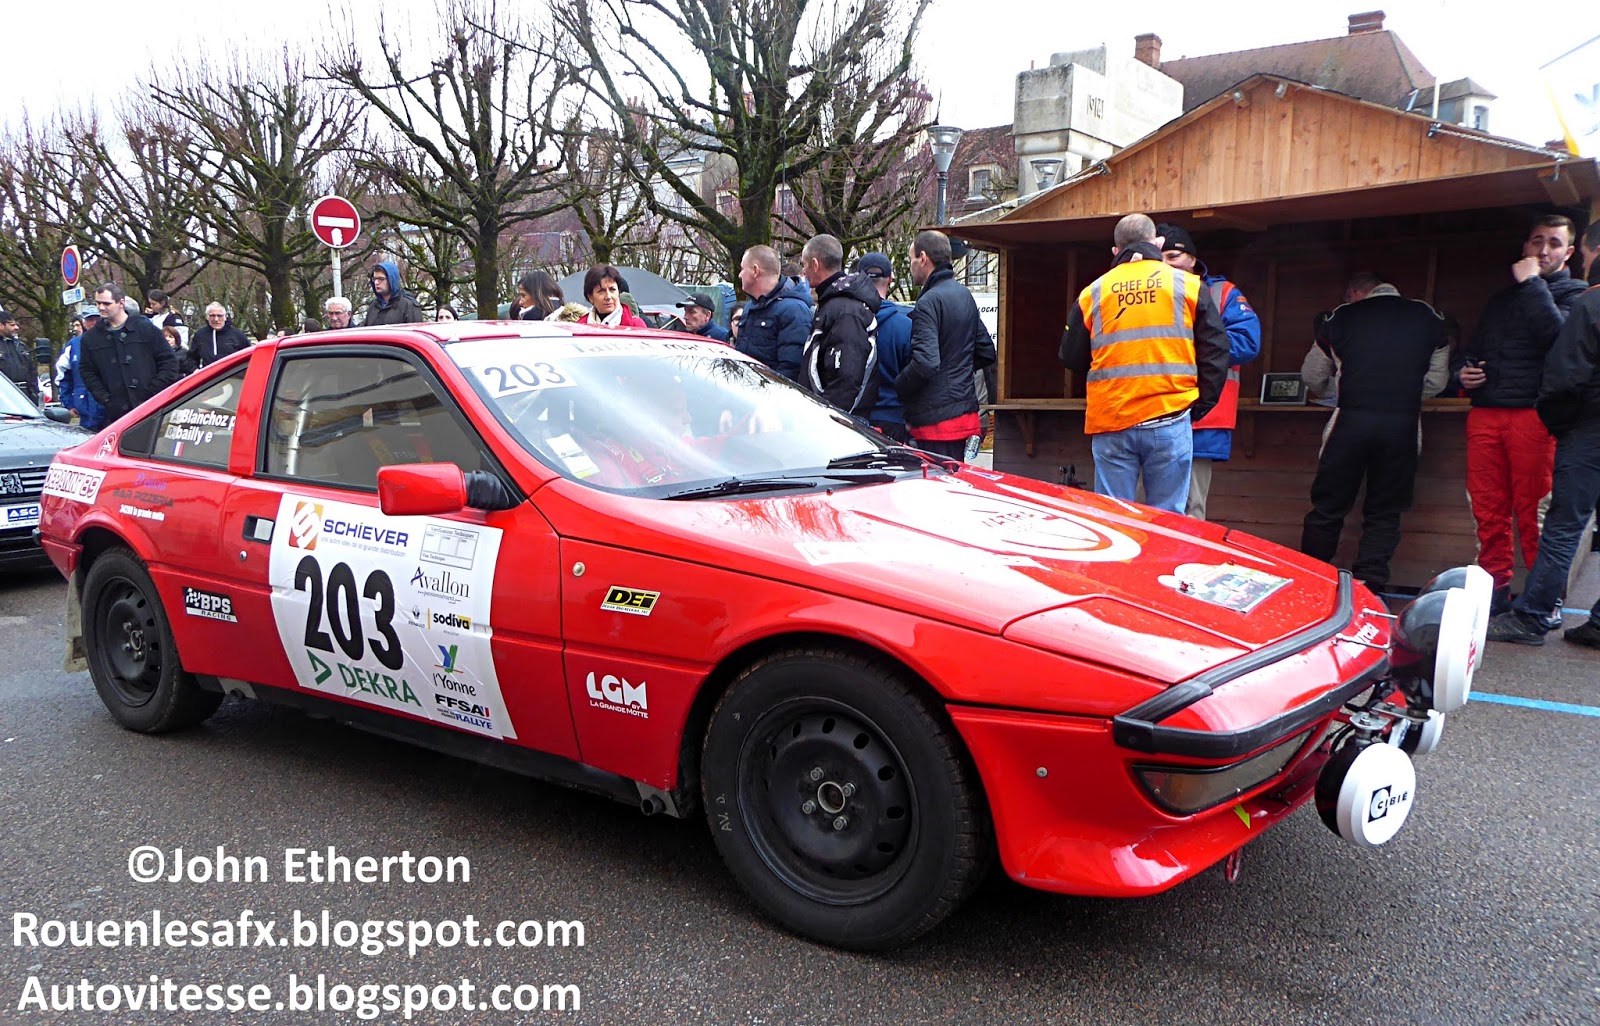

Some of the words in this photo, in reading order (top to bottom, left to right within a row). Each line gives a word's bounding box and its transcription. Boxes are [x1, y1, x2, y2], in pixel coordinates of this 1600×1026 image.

[1111, 280, 1142, 294] CHEF
[1146, 278, 1162, 289] DE
[1118, 290, 1156, 307] POSTE
[483, 362, 566, 393] 203
[180, 409, 229, 426] Blanchoz
[175, 425, 205, 445] bailly
[204, 431, 213, 443] e
[8, 507, 38, 518] ASC
[410, 566, 470, 598] Avallon
[200, 593, 231, 614] BPS
[294, 555, 404, 671] 203
[201, 610, 231, 621] RACING
[433, 612, 470, 630] sodiva
[337, 662, 423, 708] DEKRA
[433, 673, 476, 696] l'Yonne
[586, 671, 648, 710] LGM
[435, 693, 486, 717] FFSA
[589, 699, 600, 708] LA
[599, 701, 626, 714] GRANDE
[626, 707, 649, 719] MOTTE
[455, 713, 493, 730] RALLYE
